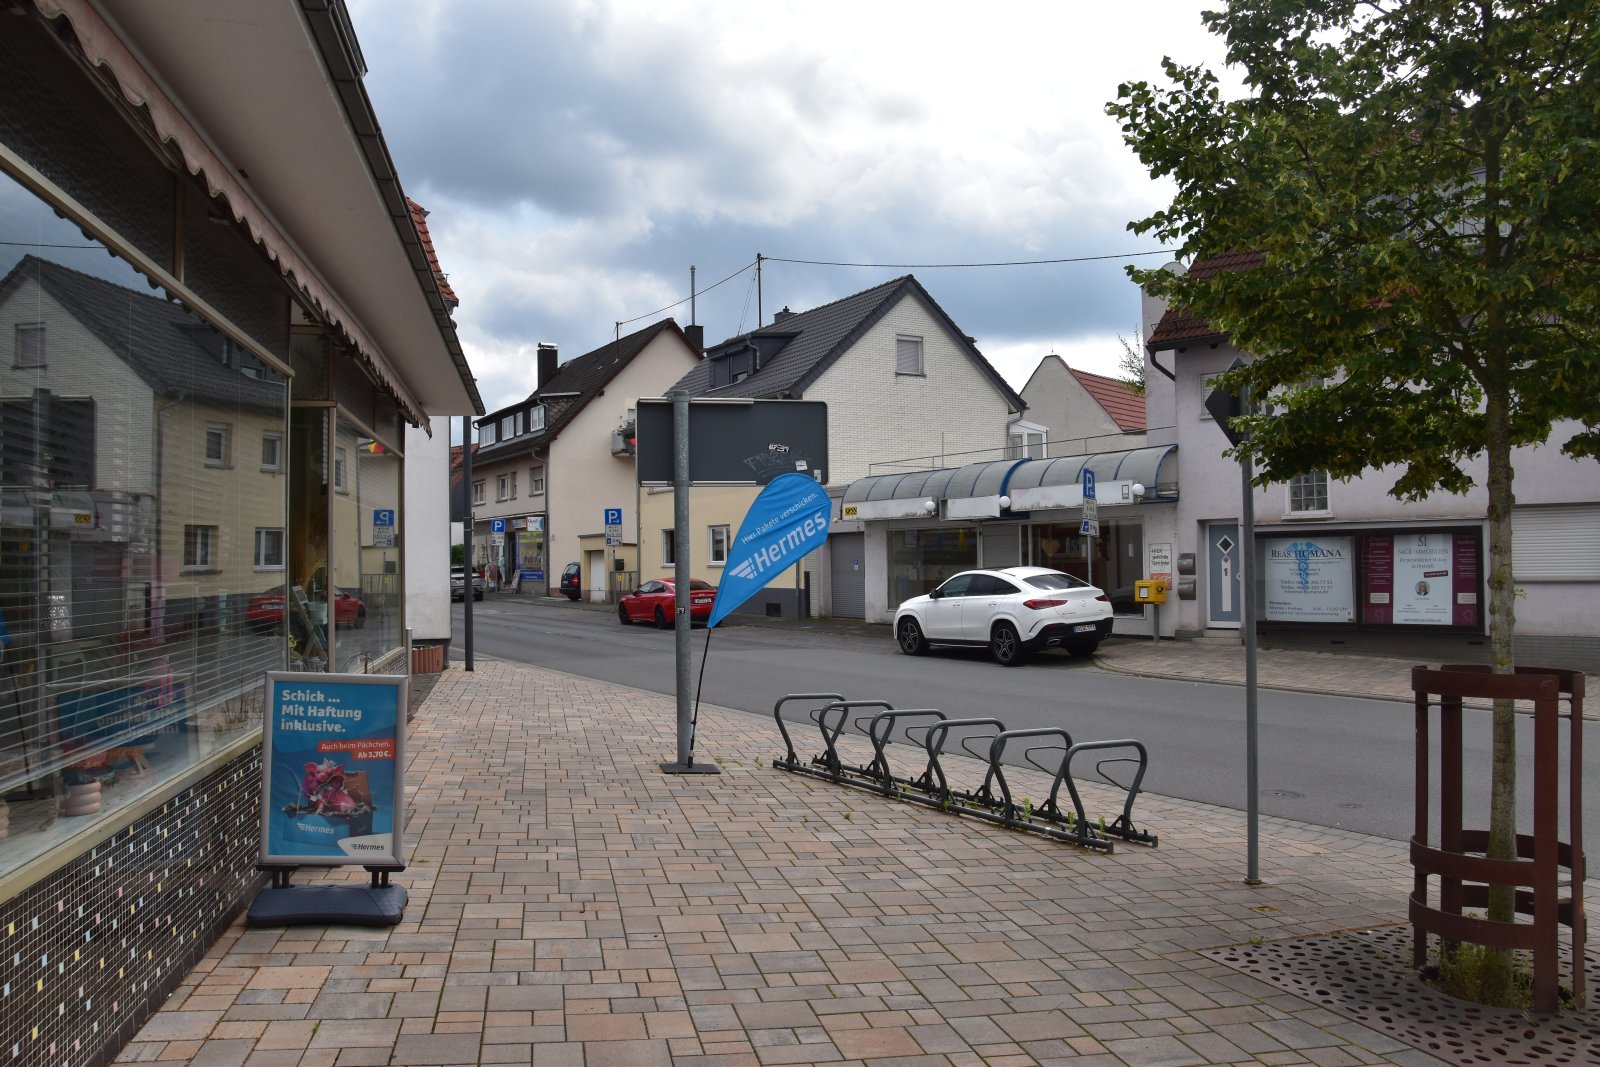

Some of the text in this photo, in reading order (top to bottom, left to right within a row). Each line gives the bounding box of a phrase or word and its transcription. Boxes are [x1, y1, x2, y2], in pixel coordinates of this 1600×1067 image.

[608, 510, 618, 524] P
[741, 492, 819, 545] Hier Pakete verschicken.
[494, 520, 503, 532] P
[753, 511, 827, 573] Hermes
[1223, 568, 1228, 576] 1
[281, 689, 325, 702] Schick
[281, 704, 362, 721] Mit Haftung
[280, 719, 346, 733] inklusive.
[357, 741, 391, 749] Päckchen.
[357, 751, 368, 759] Ab
[304, 823, 335, 835] Hermes
[357, 843, 385, 851] Hermes
